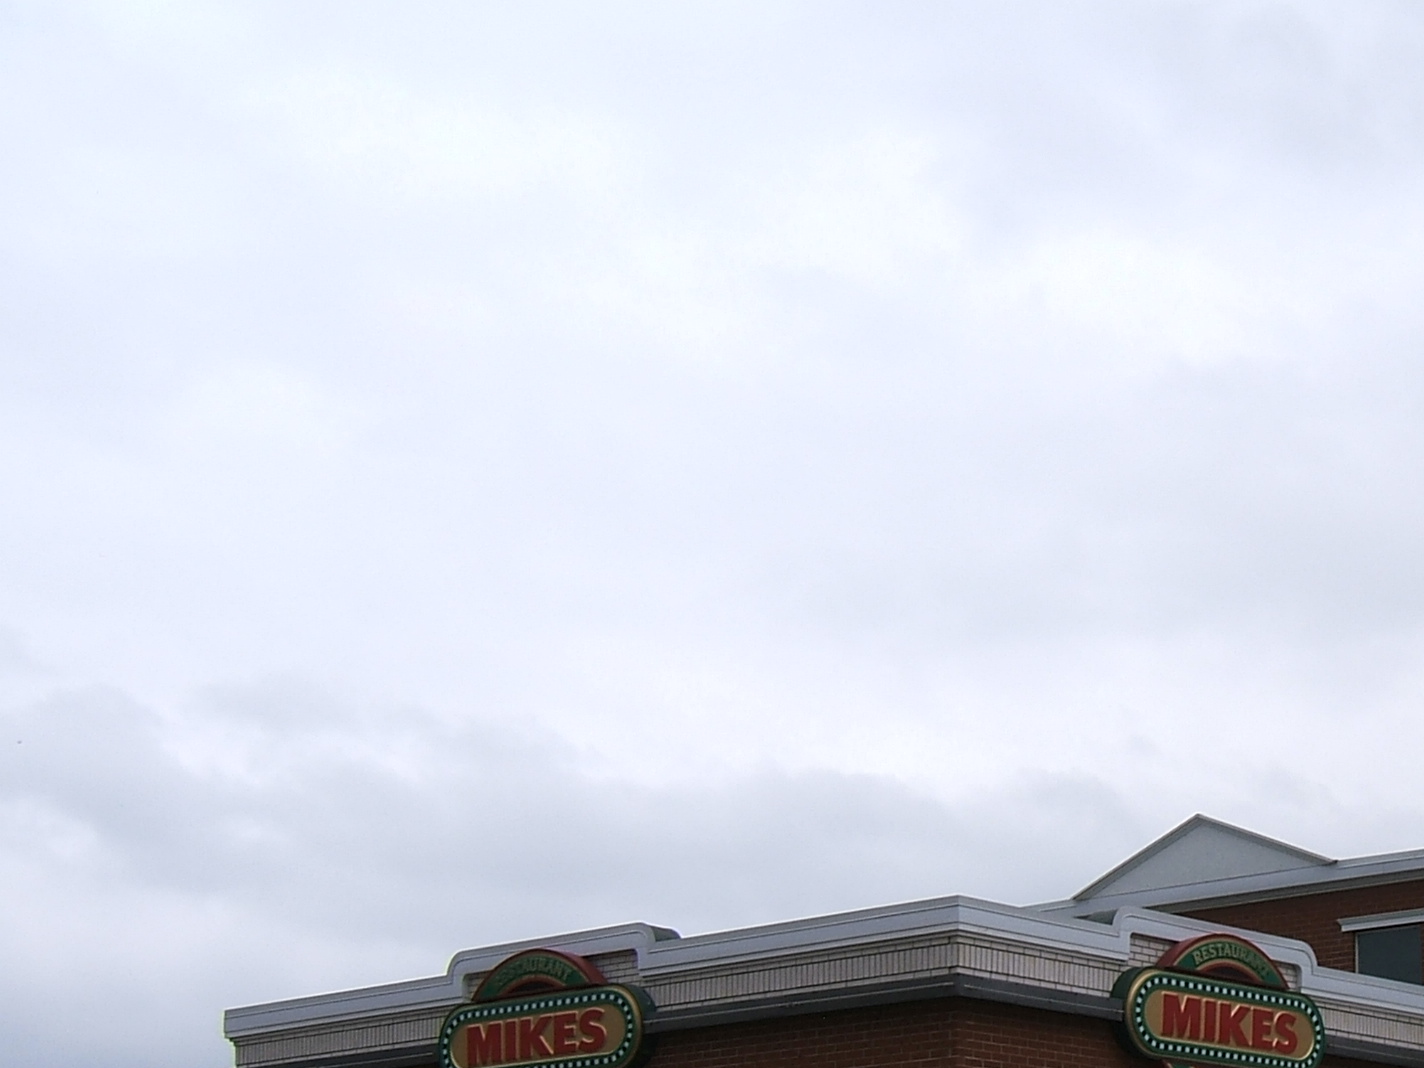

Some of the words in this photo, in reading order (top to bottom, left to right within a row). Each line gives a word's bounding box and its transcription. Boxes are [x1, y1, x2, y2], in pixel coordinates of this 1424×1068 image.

[1193, 942, 1271, 981] RESTAURANT
[466, 1007, 608, 1068] MIKES
[1160, 991, 1299, 1055] MIKES
